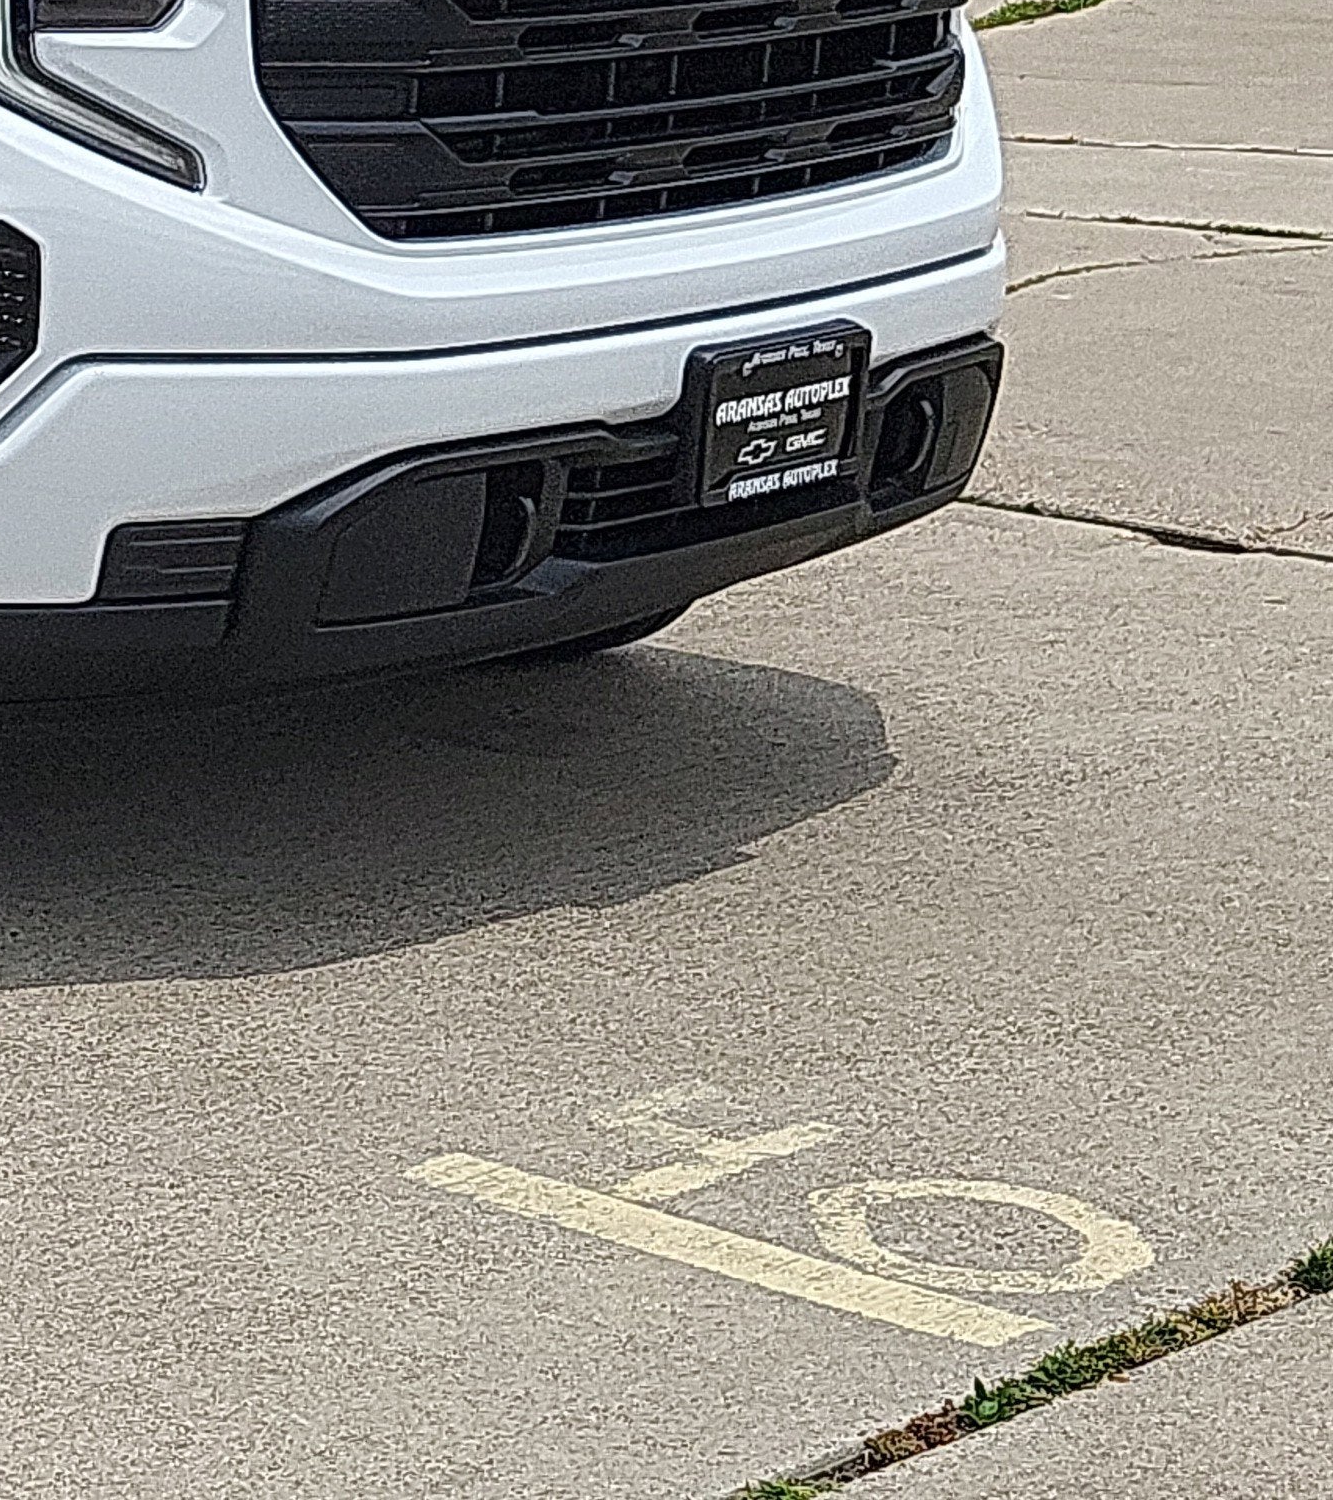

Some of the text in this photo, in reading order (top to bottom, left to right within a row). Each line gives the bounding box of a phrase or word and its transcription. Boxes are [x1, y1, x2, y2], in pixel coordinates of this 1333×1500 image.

[716, 375, 852, 426] ARANSAS AUTOPLEX
[786, 428, 828, 452] GMC
[728, 458, 839, 502] ARANSAS AUTOPLEX
